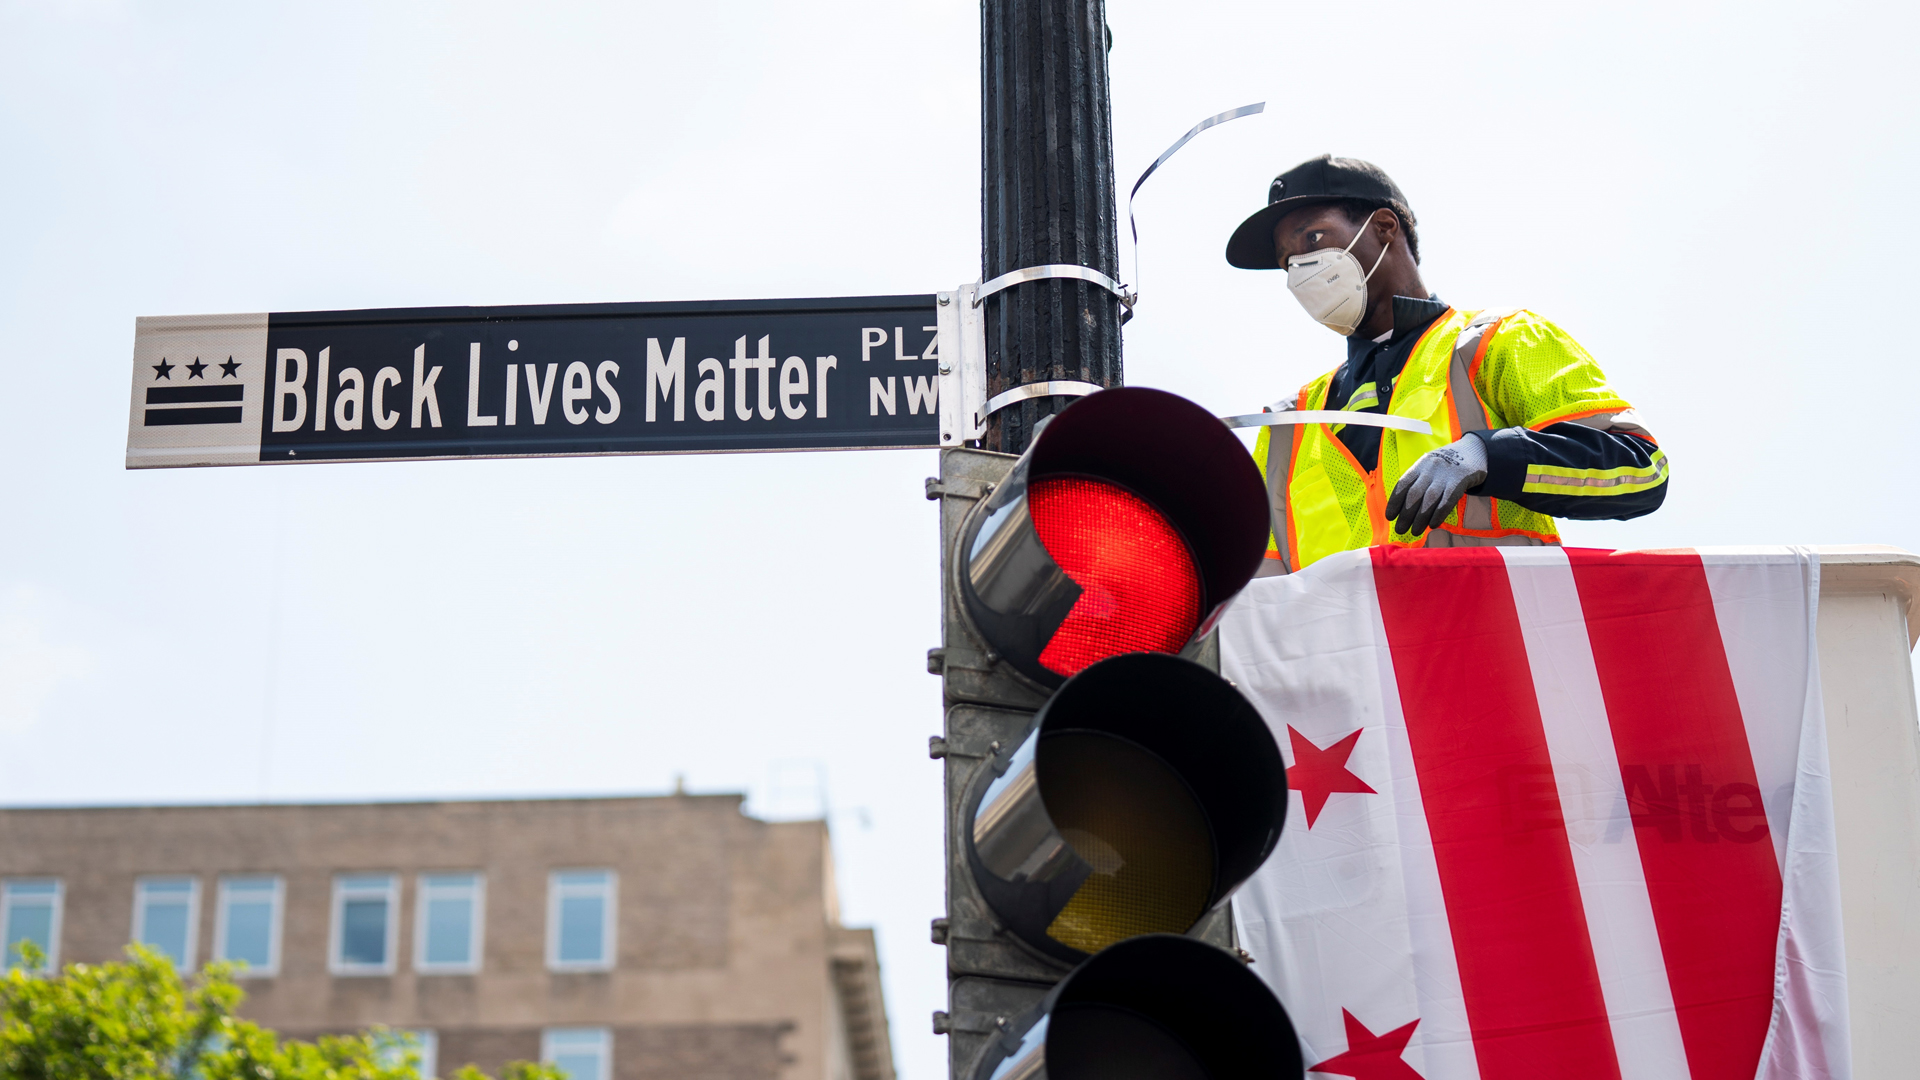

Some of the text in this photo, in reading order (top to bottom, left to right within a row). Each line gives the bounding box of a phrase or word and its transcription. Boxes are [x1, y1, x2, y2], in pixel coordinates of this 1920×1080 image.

[861, 326, 939, 362] PLZ
[271, 334, 838, 432] Black Lives Matter
[869, 375, 940, 416] NW
